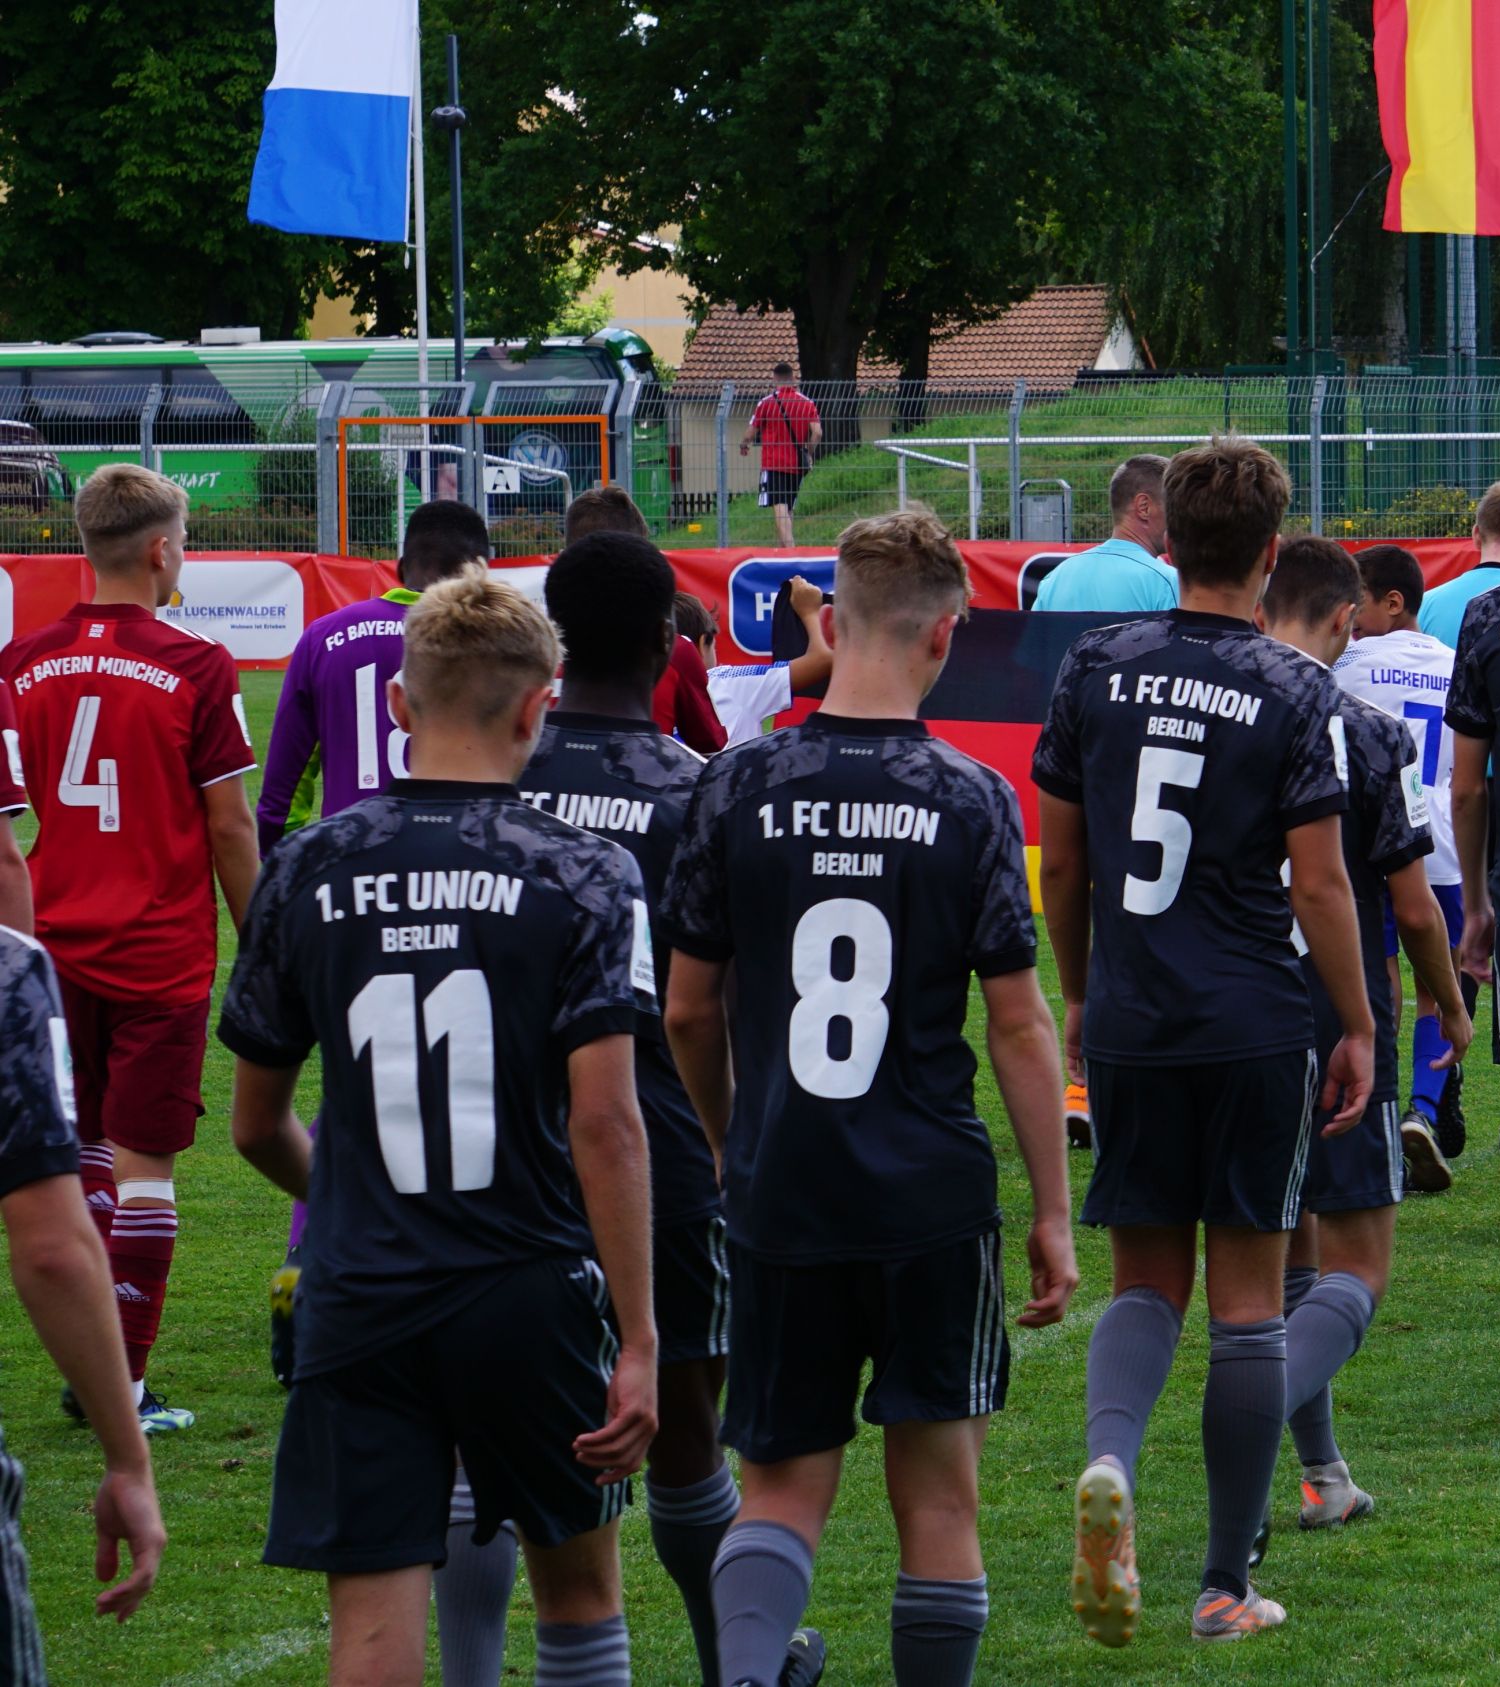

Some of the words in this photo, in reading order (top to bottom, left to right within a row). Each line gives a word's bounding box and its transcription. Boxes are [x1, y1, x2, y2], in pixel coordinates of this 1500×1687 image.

[491, 469, 511, 491] A
[166, 608, 182, 617] DIE
[184, 605, 287, 618] LUCKENWALDER
[325, 631, 346, 652] FC
[347, 620, 406, 641] BAYERN
[14, 672, 33, 695] FC
[32, 656, 94, 683] BAYERN
[1108, 673, 1127, 702] 1.
[1135, 674, 1169, 705] FC
[1168, 677, 1263, 731] UNION
[1146, 716, 1206, 742] BERLIN
[1403, 701, 1443, 787] 7
[57, 695, 121, 833] 4
[555, 793, 655, 835] UNION
[758, 803, 784, 839] 1.
[792, 800, 830, 837] FC
[838, 802, 940, 846] UNION
[1122, 745, 1205, 916] 5
[812, 852, 883, 877] BERLIN
[315, 883, 344, 922] 1.
[353, 873, 399, 915] FC
[407, 870, 524, 916] UNION
[381, 924, 459, 953] BERLIN
[788, 897, 893, 1099] 8
[347, 969, 496, 1194] 11
